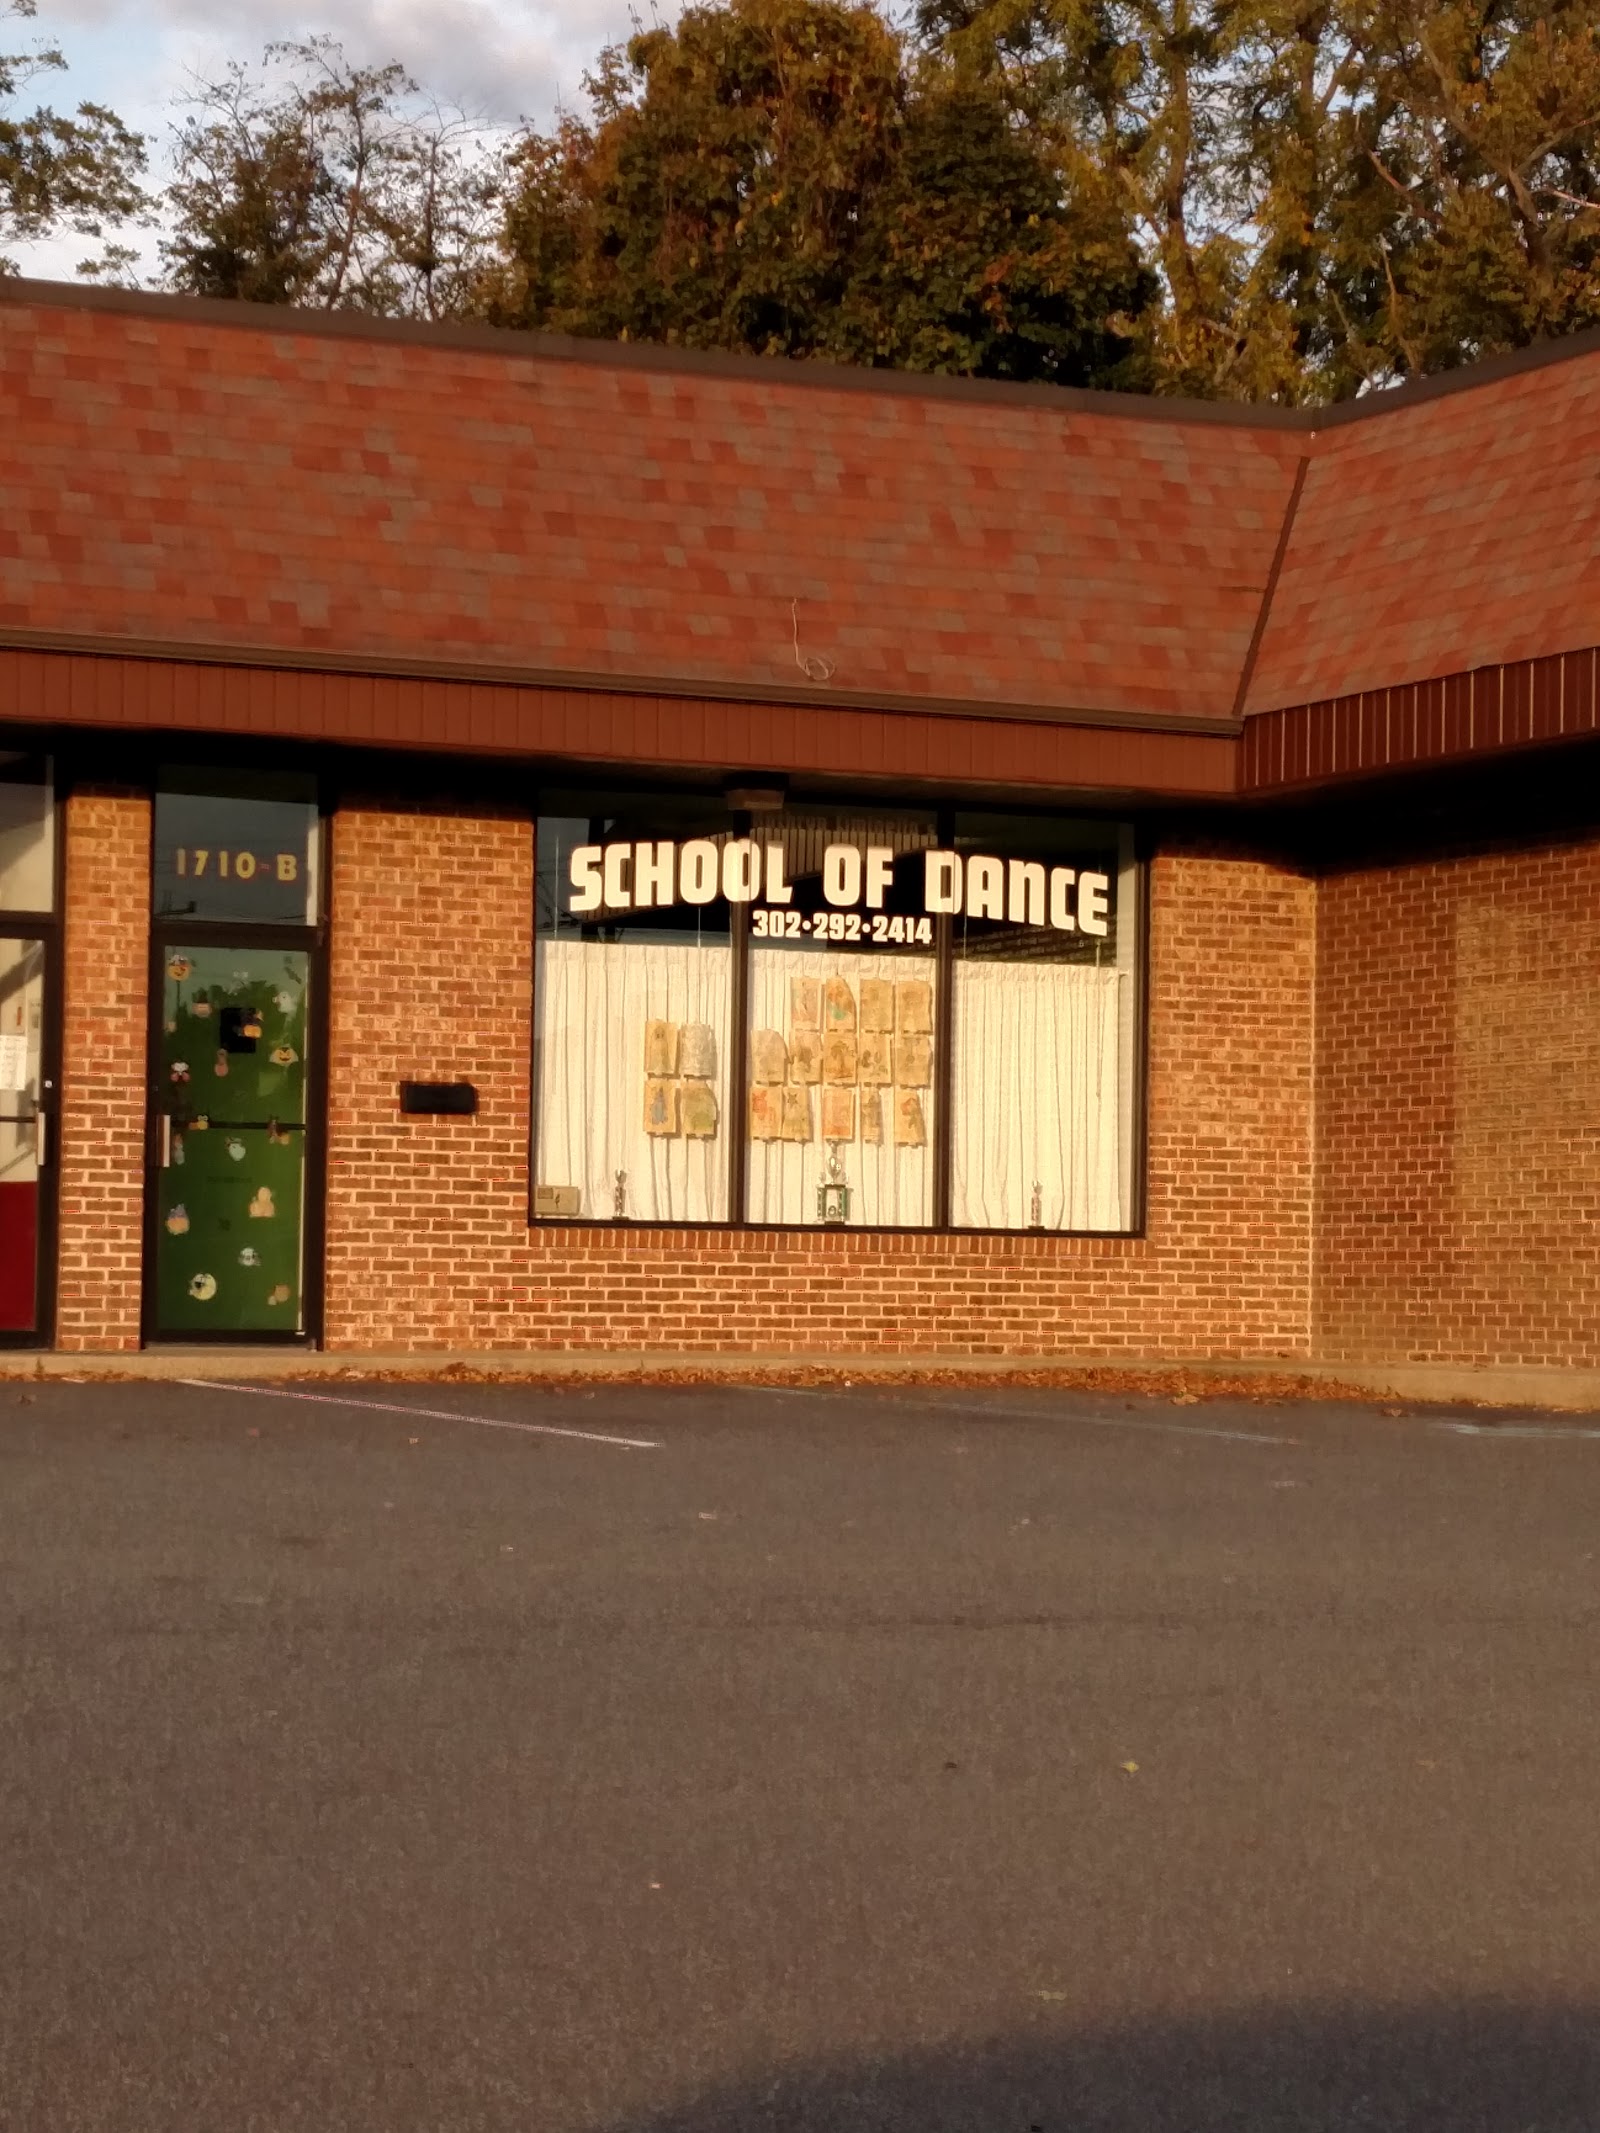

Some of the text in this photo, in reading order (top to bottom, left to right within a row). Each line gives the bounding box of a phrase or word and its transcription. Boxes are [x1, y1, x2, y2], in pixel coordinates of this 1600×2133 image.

[176, 848, 299, 881] 1710-B
[569, 839, 1108, 936] SCHOOL OF DANCE
